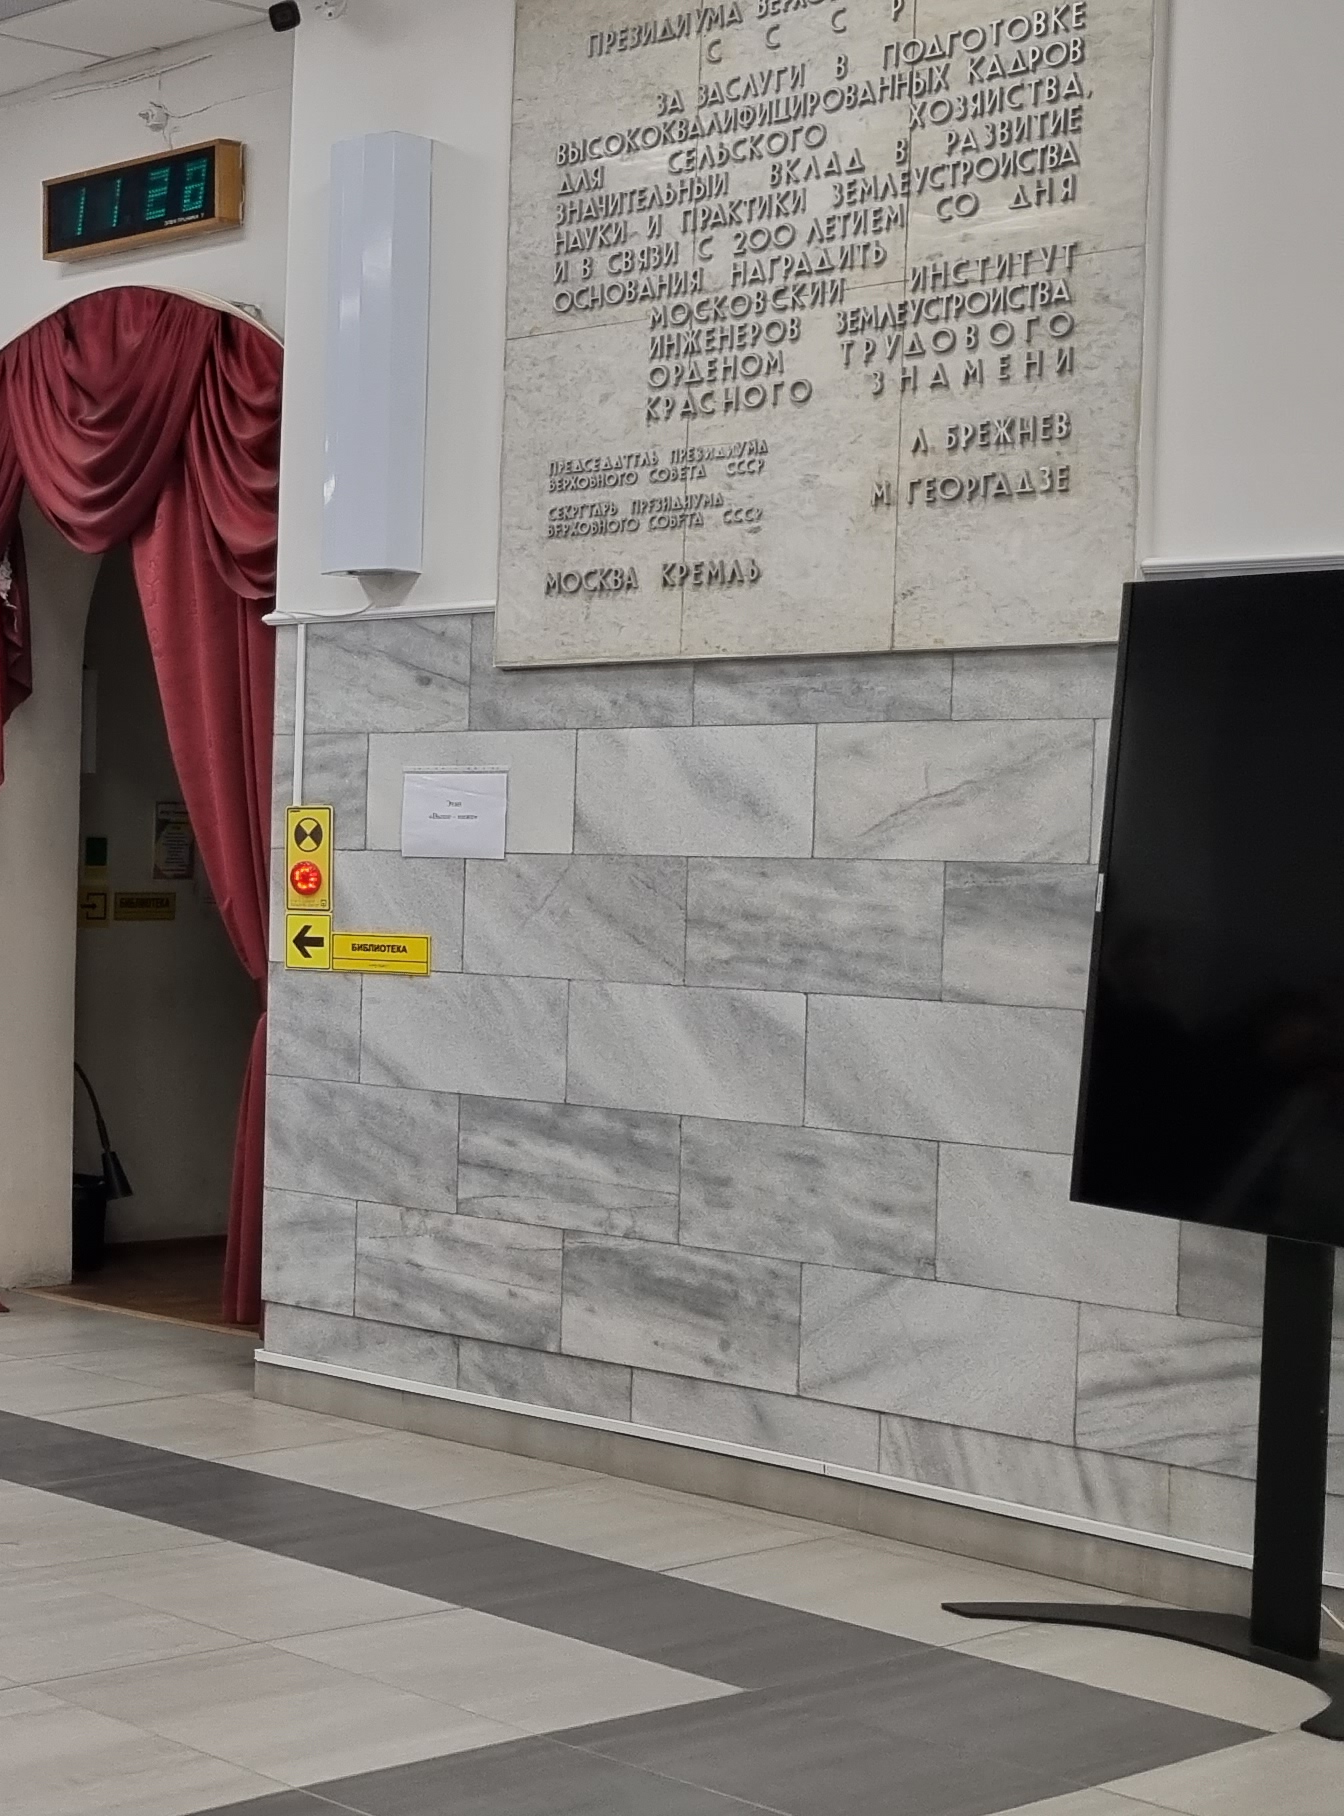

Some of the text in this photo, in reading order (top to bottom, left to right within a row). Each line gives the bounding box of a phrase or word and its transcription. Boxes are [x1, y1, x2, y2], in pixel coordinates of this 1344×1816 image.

[588, 2, 743, 58] ПРЕЗИДИУМА
[657, 1, 1086, 117] ЗА ЗАСЛУГИ В ПОДГОТОВКЕ
[556, 37, 1084, 166] ВЫСОКОКВАЛИФИЦИРОВАННЫХ КАДРОВ
[557, 165, 605, 196] ДЛЯ
[668, 122, 827, 175] СЕЛЬСКОГО
[769, 147, 865, 188] ВКЛАД
[895, 138, 909, 166] В
[946, 104, 1083, 156] РАЗВИТИЕ
[553, 172, 1078, 284] И В СВЯЗИ С 200 ЛЕТИЕМ СО ДНЯ
[554, 219, 628, 255] НАУКИ
[647, 213, 662, 240] И
[681, 187, 807, 235] ПРАКТИКИ
[553, 240, 888, 313] ОСНОВАНИЯ НАГРАДИТЬ
[910, 241, 1079, 293] ИНСТИТУТ
[648, 312, 1075, 389] ОРДЕНОМ ТРУДОВОГО
[649, 316, 802, 361] ИНЖЕНЕРОВ
[646, 346, 1075, 425] КРАСНОГО ЗНАМЕНИ
[670, 438, 769, 465] ПРЕЗИДИУМА
[944, 411, 1072, 450] БРЕЖНЕВ
[548, 458, 765, 493] ВЕРХОВНОГО СОВЕТА СССР
[906, 465, 1070, 505] ГЕОРГАДЗЕ
[548, 507, 763, 539] ВЕРХОВНОГО СОВЕТА СССР
[545, 559, 761, 595] МОСКВА КРЕМЛЬ
[352, 943, 408, 954] БИБЛИОТЕКА
